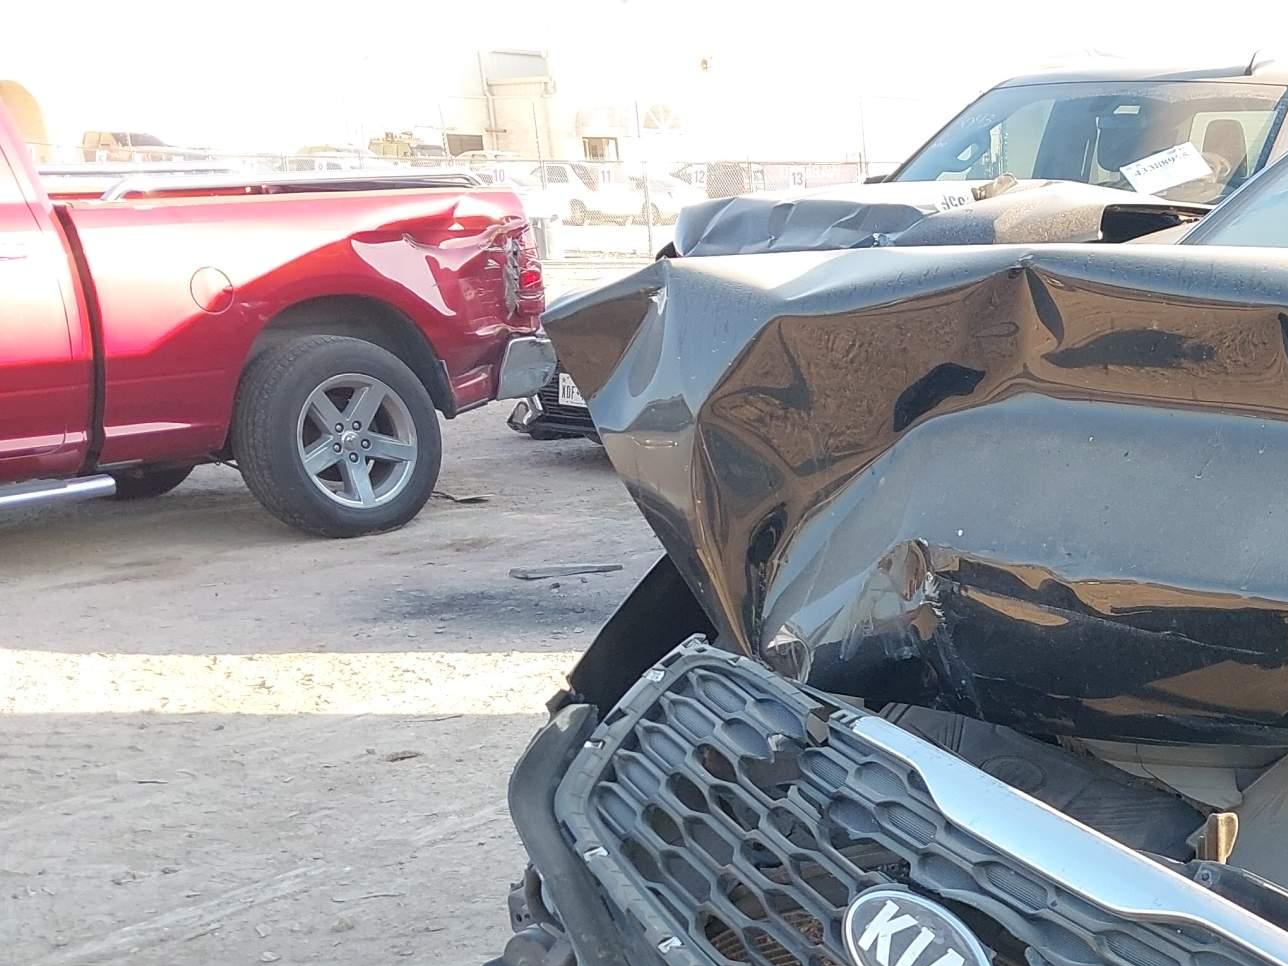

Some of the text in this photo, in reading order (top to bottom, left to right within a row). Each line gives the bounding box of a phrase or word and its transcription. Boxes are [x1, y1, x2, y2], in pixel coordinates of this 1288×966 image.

[493, 169, 505, 183] 10
[601, 169, 611, 184] 11
[694, 171, 705, 184] 12
[791, 172, 804, 186] 13
